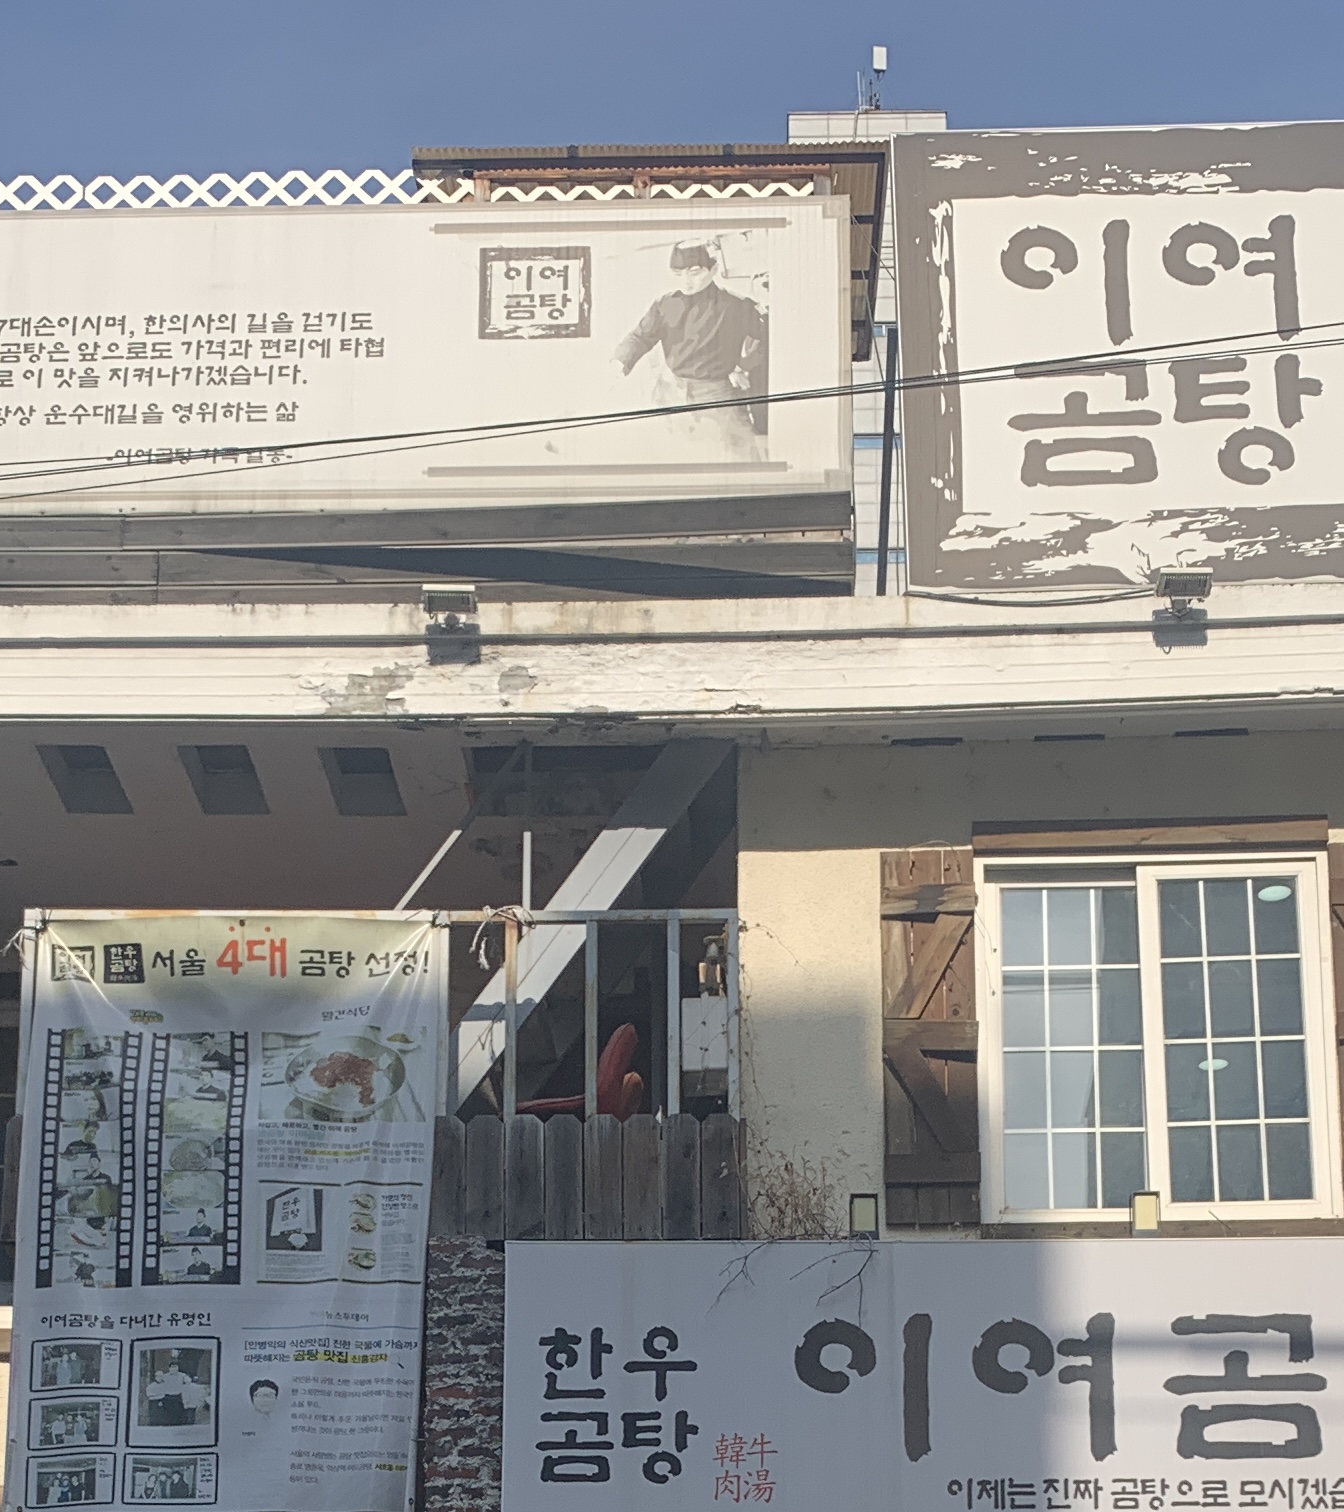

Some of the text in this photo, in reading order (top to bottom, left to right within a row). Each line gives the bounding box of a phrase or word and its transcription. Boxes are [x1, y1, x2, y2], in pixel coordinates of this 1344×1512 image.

[504, 265, 571, 293] 이여
[1001, 214, 1301, 345] 이여
[504, 293, 573, 321] 곰탕
[144, 313, 236, 335] 한의사의
[247, 312, 294, 333] 길을
[302, 312, 373, 332] 걷기도
[78, 342, 173, 362] 앞으로도
[181, 339, 253, 360] 가격과
[260, 338, 331, 359] 편리에
[340, 337, 385, 358] 타협
[23, 369, 43, 389] 이
[54, 367, 100, 389] 맛을
[109, 365, 308, 388] 지켜나가겠습니다.
[44, 404, 164, 426] 운수대길을
[172, 402, 268, 425] 영위하는
[276, 402, 299, 422] 삶
[1007, 353, 1323, 487] 곰탕
[152, 937, 429, 979] 서울 4대 곰탕 선정!
[41, 1312, 212, 1329] 이여곰탕을 다녀간 유명인
[292, 1349, 319, 1362] 곰탕
[323, 1350, 349, 1364] 맛집
[538, 1325, 697, 1402] 한우
[535, 1410, 699, 1485] 곰탕
[713, 1433, 778, 1469] 韓牛
[714, 1469, 776, 1503] 肉湯
[947, 1477, 1037, 1511] 이제는
[1042, 1477, 1104, 1511] 진짜
[1111, 1477, 1231, 1512] 곰탕으로
